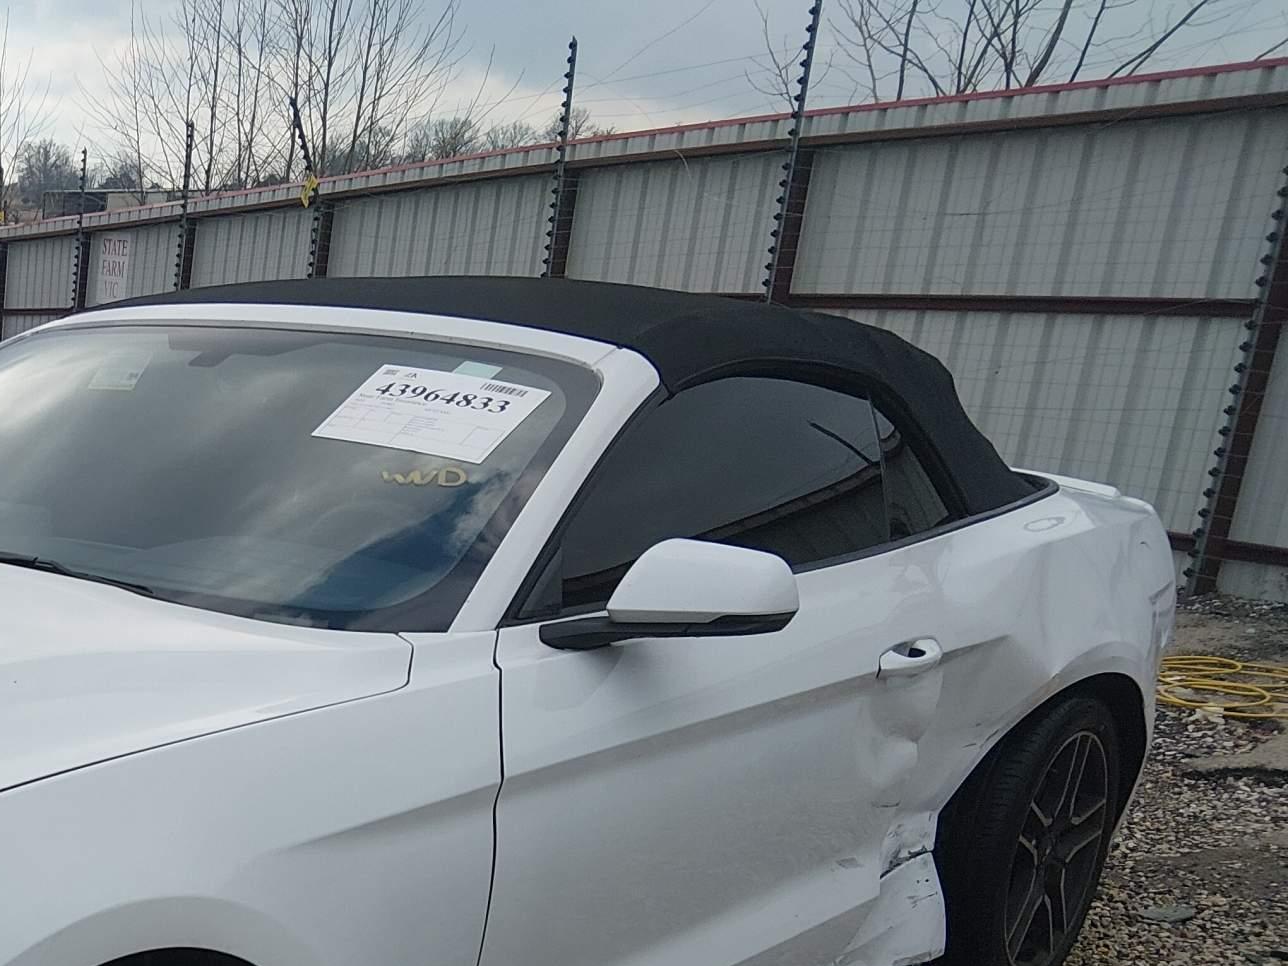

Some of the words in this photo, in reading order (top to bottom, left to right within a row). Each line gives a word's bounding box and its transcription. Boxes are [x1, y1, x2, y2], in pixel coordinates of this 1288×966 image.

[103, 238, 128, 257] STATE
[102, 260, 125, 278] FARM
[375, 382, 510, 414] 43964833
